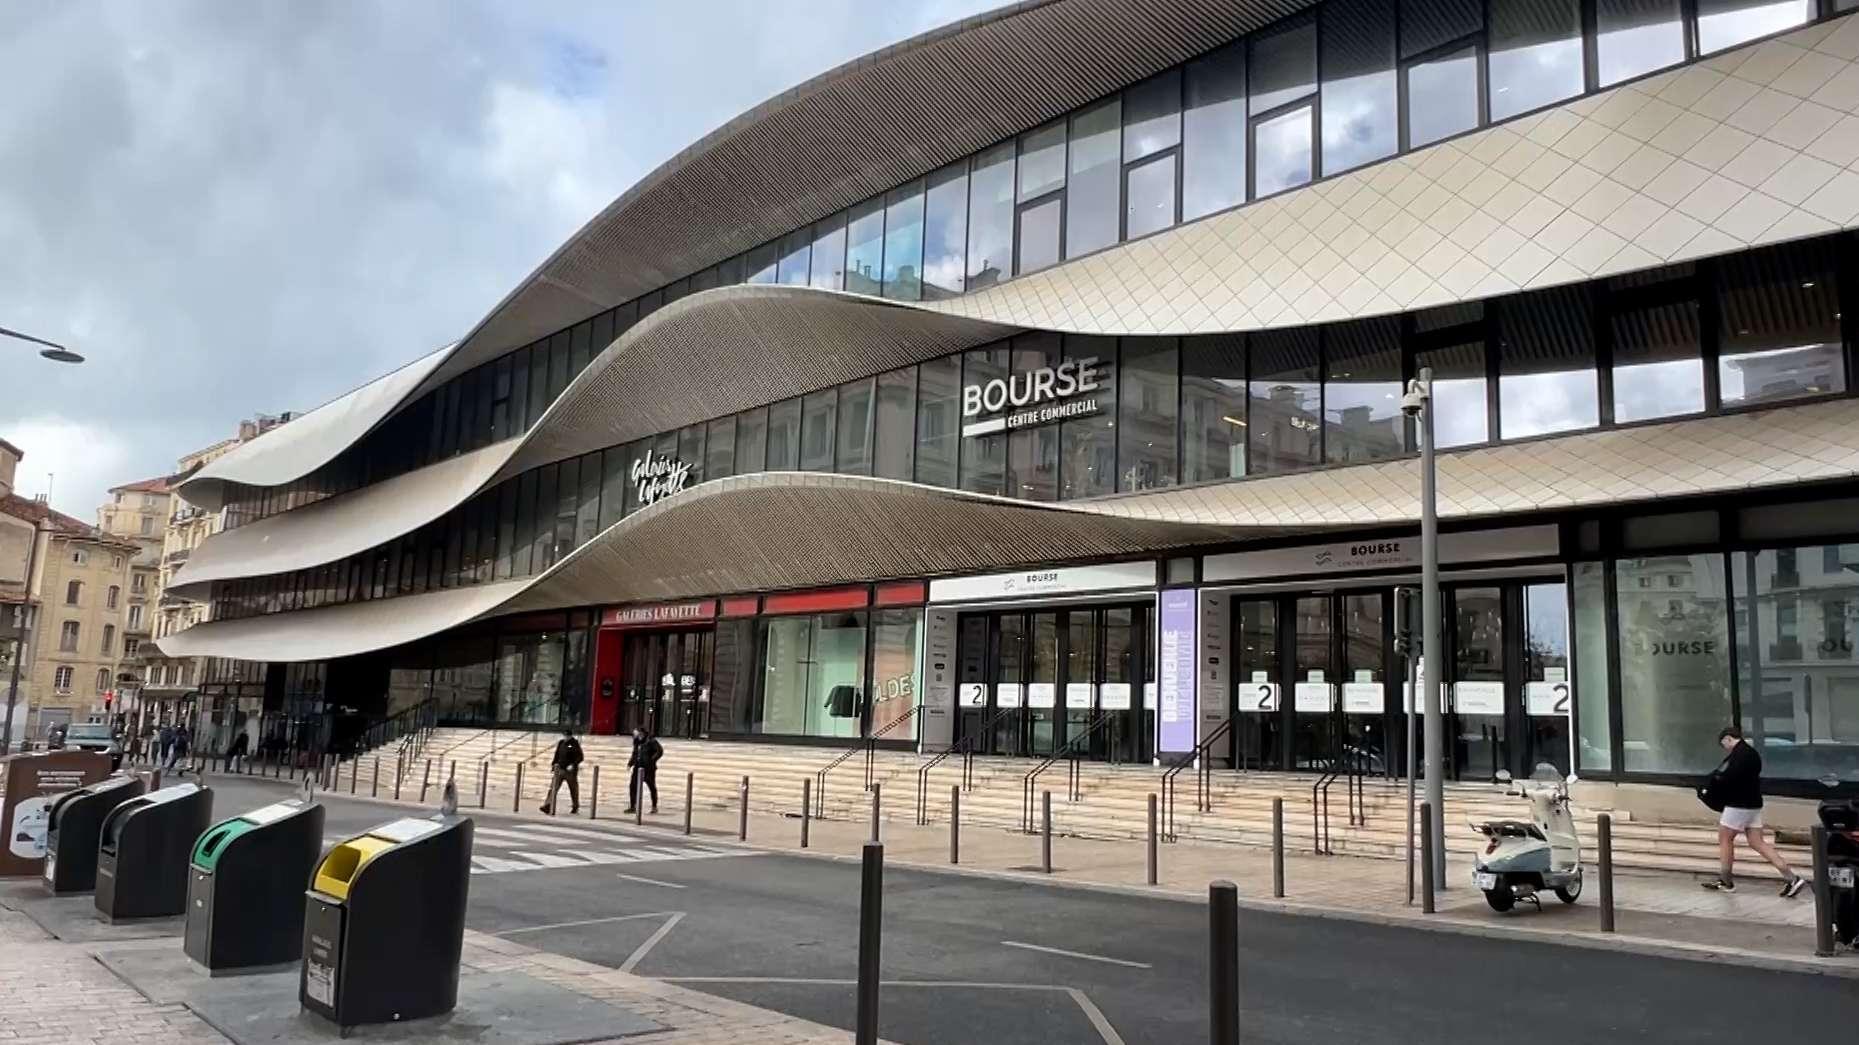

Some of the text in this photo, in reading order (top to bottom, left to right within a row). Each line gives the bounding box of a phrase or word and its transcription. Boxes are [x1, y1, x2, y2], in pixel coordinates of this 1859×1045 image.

[963, 357, 1099, 416] BOURSE
[1007, 400, 1098, 428] CENTRE COMMERCIAL
[1351, 543, 1400, 556] BOURSE
[1026, 573, 1058, 583] BOURSE
[616, 605, 700, 622] GALERIES LAFAYETTE
[972, 685, 983, 704] 2
[1258, 685, 1272, 709] 2
[1553, 683, 1569, 713] 2
